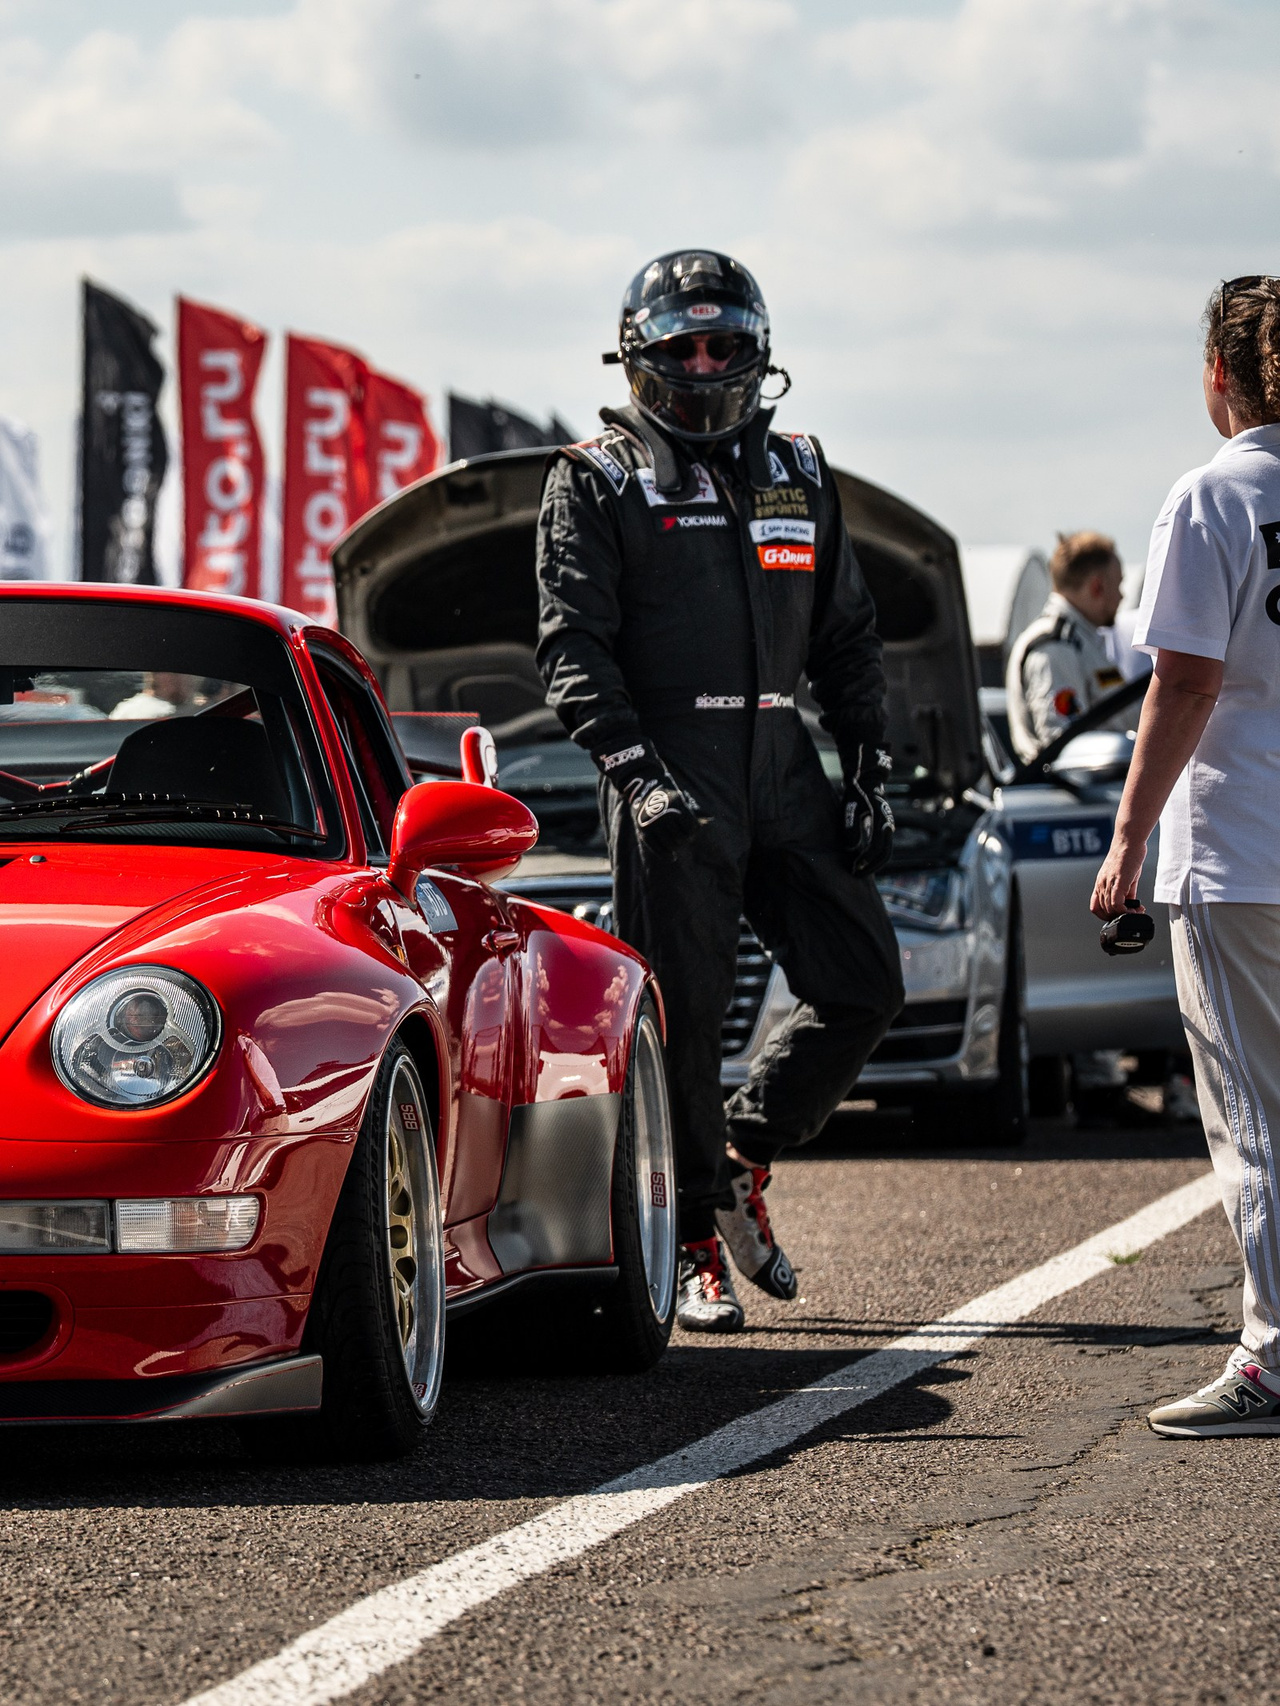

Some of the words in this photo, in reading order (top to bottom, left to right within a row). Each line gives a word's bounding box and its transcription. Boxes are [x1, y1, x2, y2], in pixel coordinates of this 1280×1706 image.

[692, 305, 718, 315] BELL
[196, 348, 253, 596] uto.ru
[296, 387, 350, 624] uto.ru
[676, 515, 728, 527] YOKOHAMA
[696, 695, 746, 709] sparco
[1051, 827, 1102, 854] ВТБ
[400, 1104, 419, 1131] BBS
[652, 1173, 665, 1206] BBS
